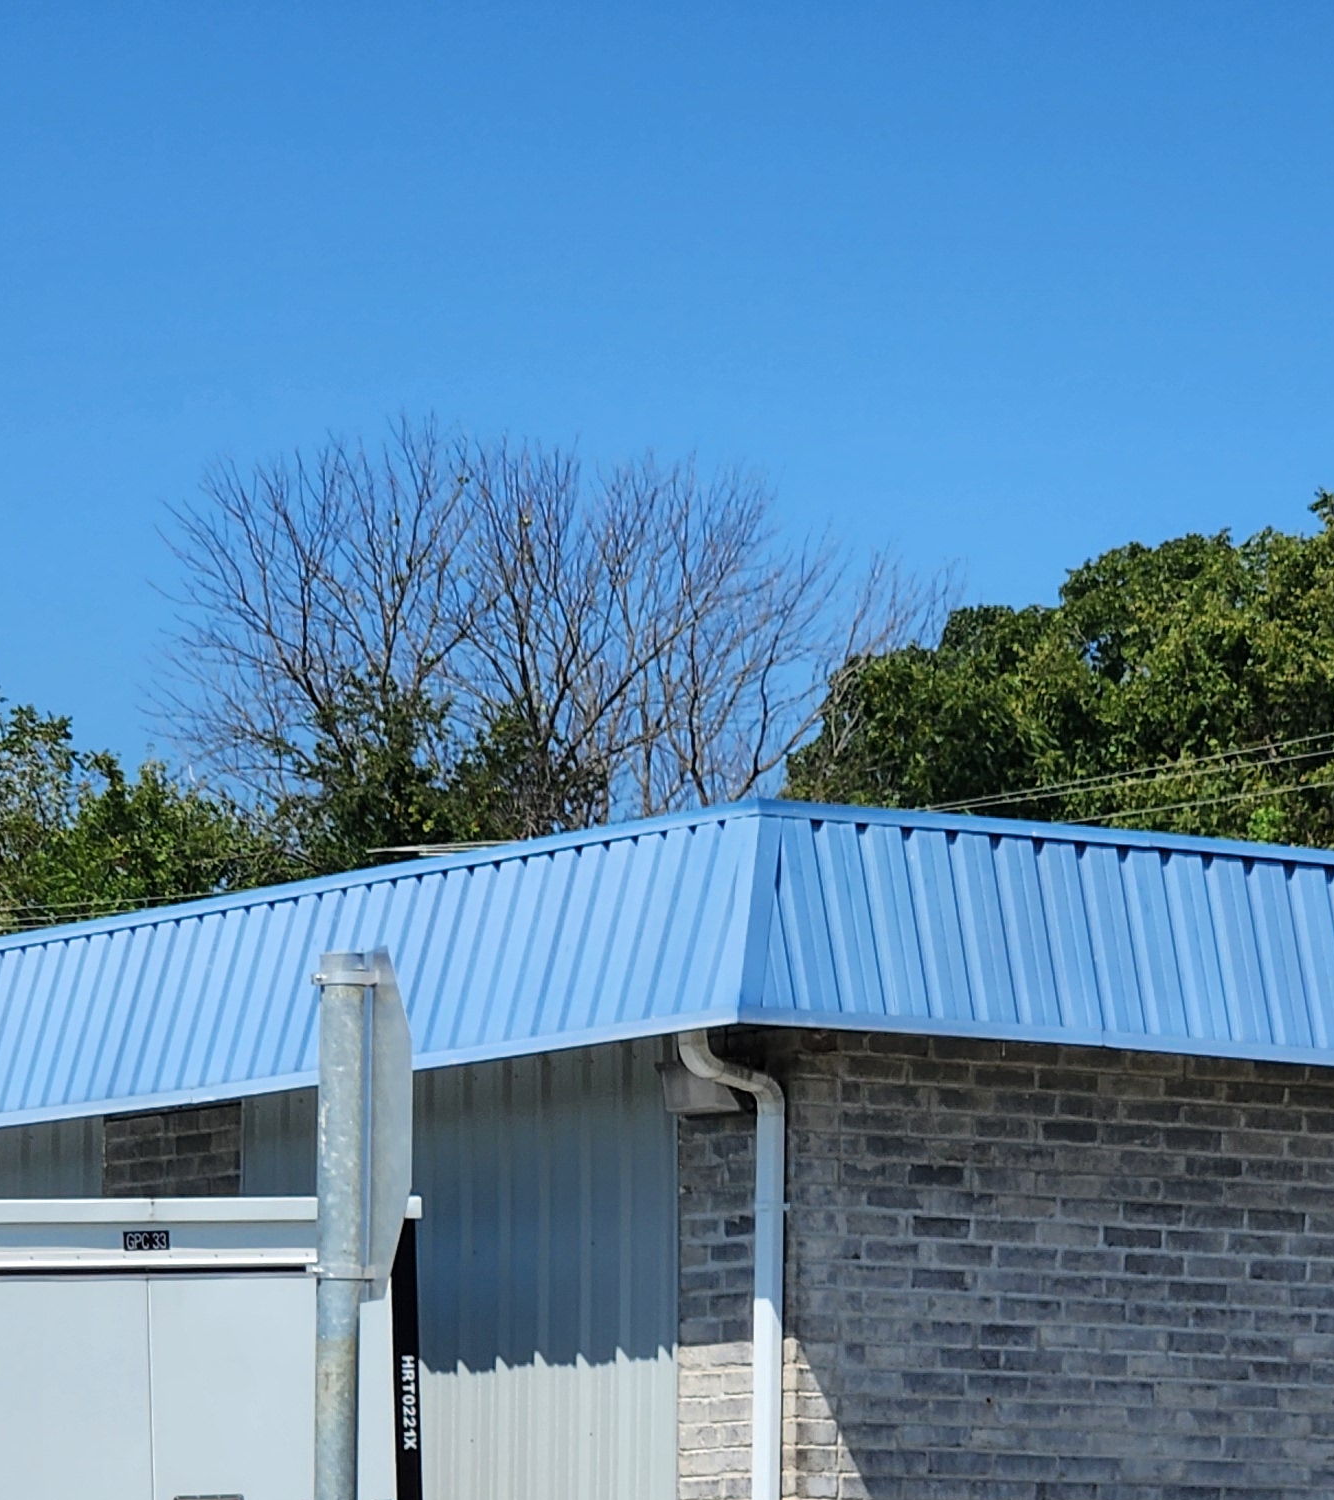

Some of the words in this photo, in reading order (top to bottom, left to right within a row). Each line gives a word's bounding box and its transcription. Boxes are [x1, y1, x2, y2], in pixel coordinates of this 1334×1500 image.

[126, 1233, 149, 1249] GPC
[153, 1232, 166, 1249] 33
[402, 1355, 417, 1450] HRT0221X
